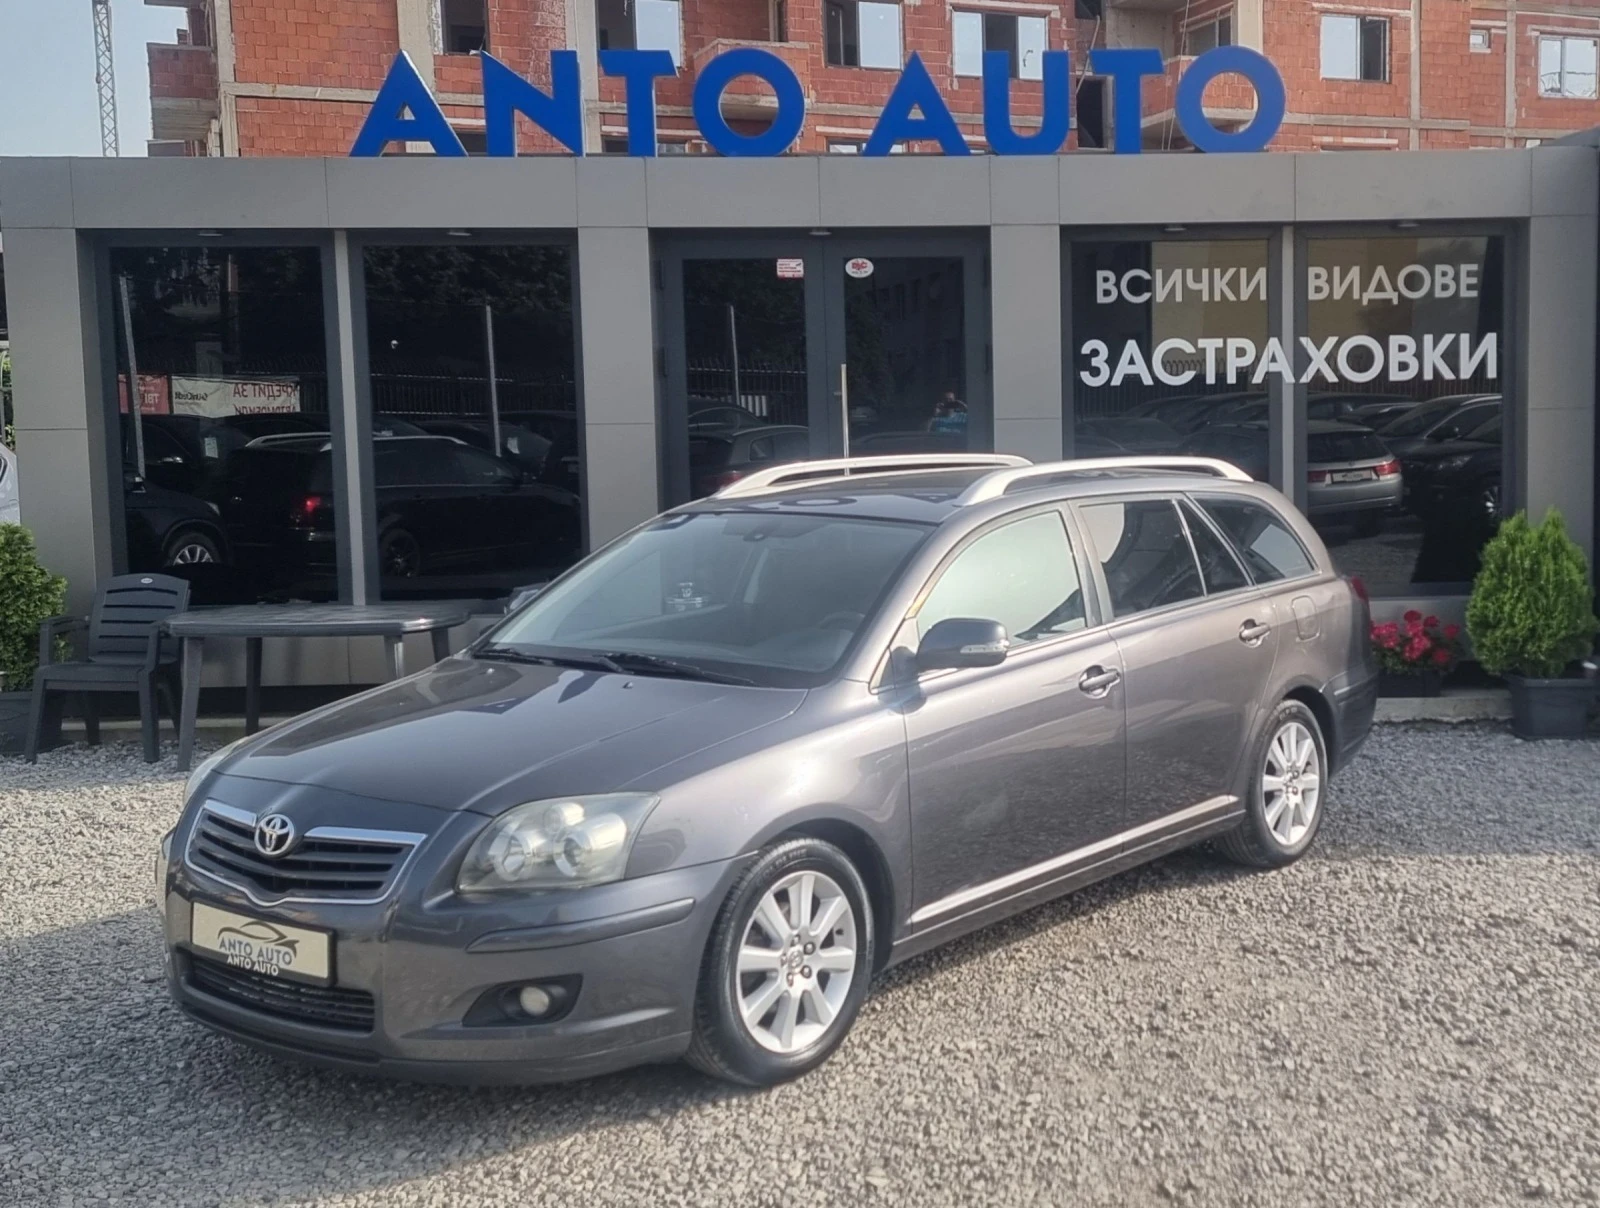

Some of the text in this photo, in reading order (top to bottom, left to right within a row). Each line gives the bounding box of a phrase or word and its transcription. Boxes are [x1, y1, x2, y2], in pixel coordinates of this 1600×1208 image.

[349, 45, 1286, 157] ANTO AUTO
[1096, 264, 1479, 306] ВСИЧКИ ВИДОВЕ
[1080, 332, 1497, 387] ЗАСТРАХОВКИ
[219, 936, 292, 966] ANTO AUTO
[227, 954, 279, 977] ANTO AUTO
